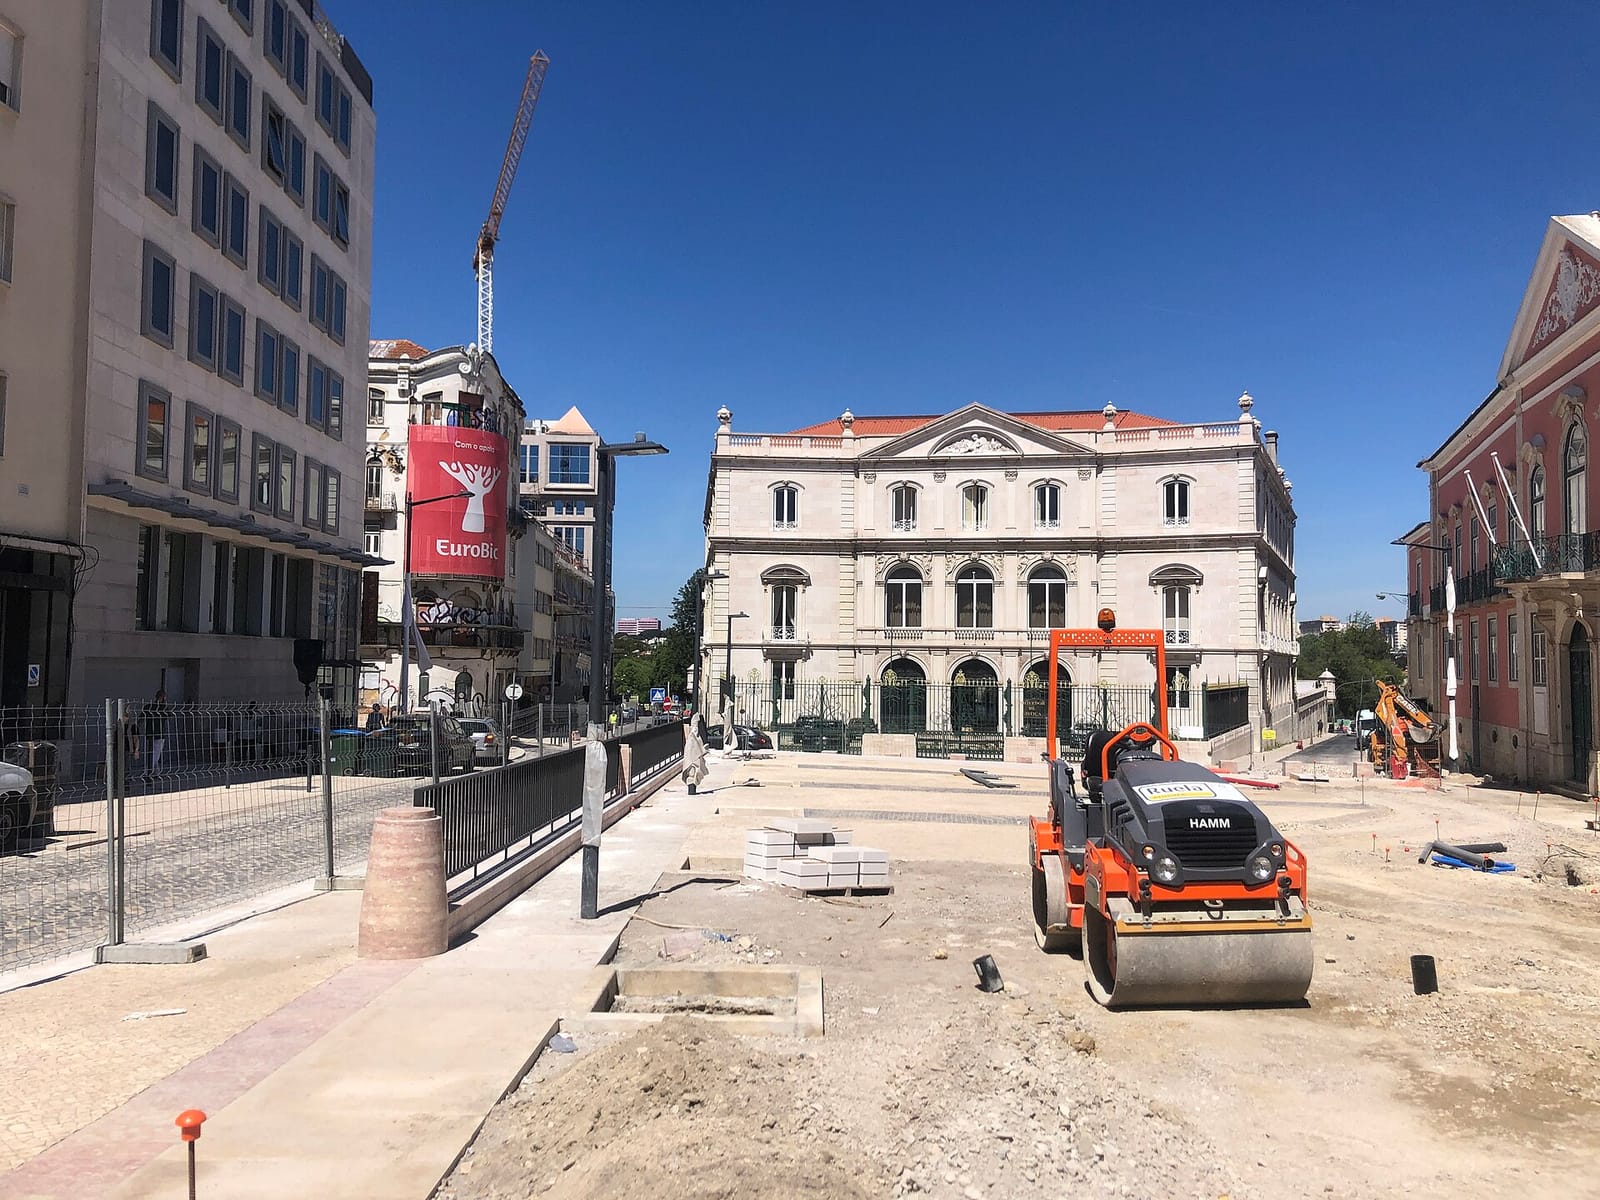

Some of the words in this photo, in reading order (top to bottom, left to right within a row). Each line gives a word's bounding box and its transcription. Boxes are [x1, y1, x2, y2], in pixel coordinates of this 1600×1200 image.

[455, 441, 472, 449] Com
[436, 539, 498, 559] EuroBic
[1190, 819, 1230, 828] HAMM
